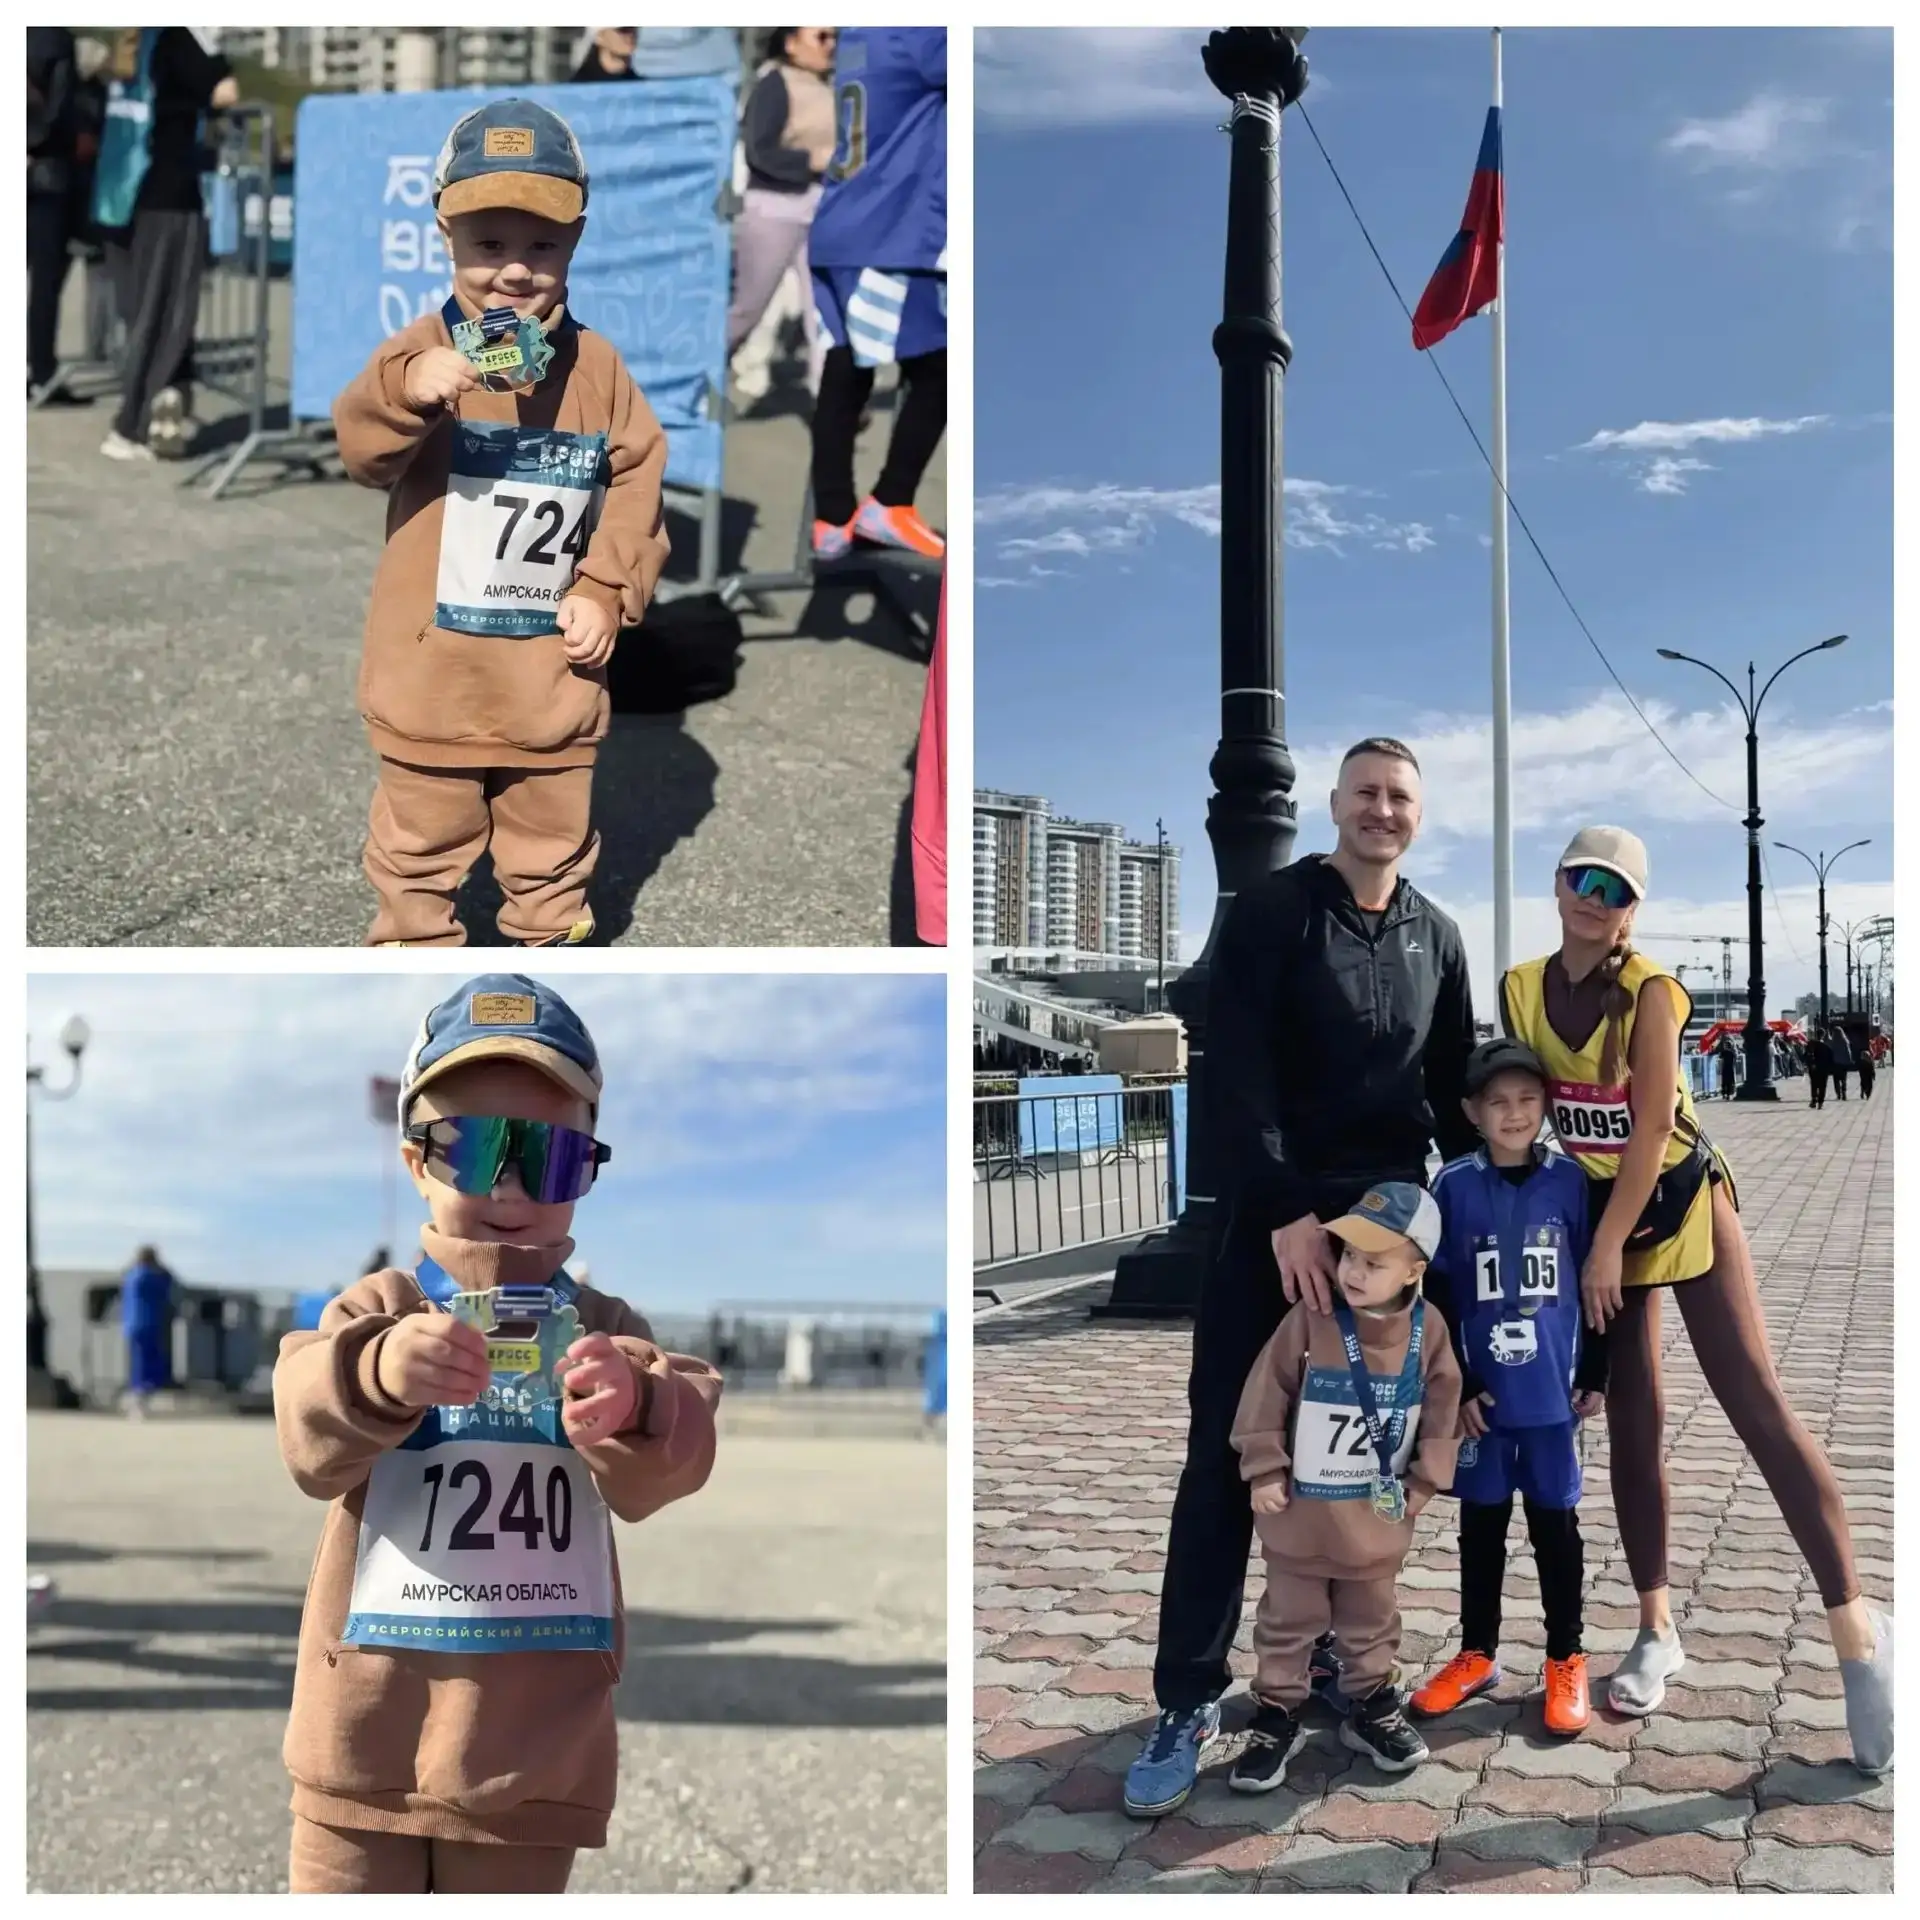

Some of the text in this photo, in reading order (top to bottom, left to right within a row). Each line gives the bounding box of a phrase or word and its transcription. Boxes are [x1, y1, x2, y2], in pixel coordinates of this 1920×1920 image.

[483, 584, 552, 601] АМУРСКАЯ
[1556, 1105, 1631, 1139] 8095
[1482, 1254, 1556, 1293] 105
[448, 1412, 535, 1428] НАЦИИ
[419, 1459, 572, 1553] 7240
[401, 1582, 578, 1602] АМУРСКАЯ ОБЛАСТЬ
[367, 1623, 523, 1639] ВСЕРОССИЙСКИЙ
